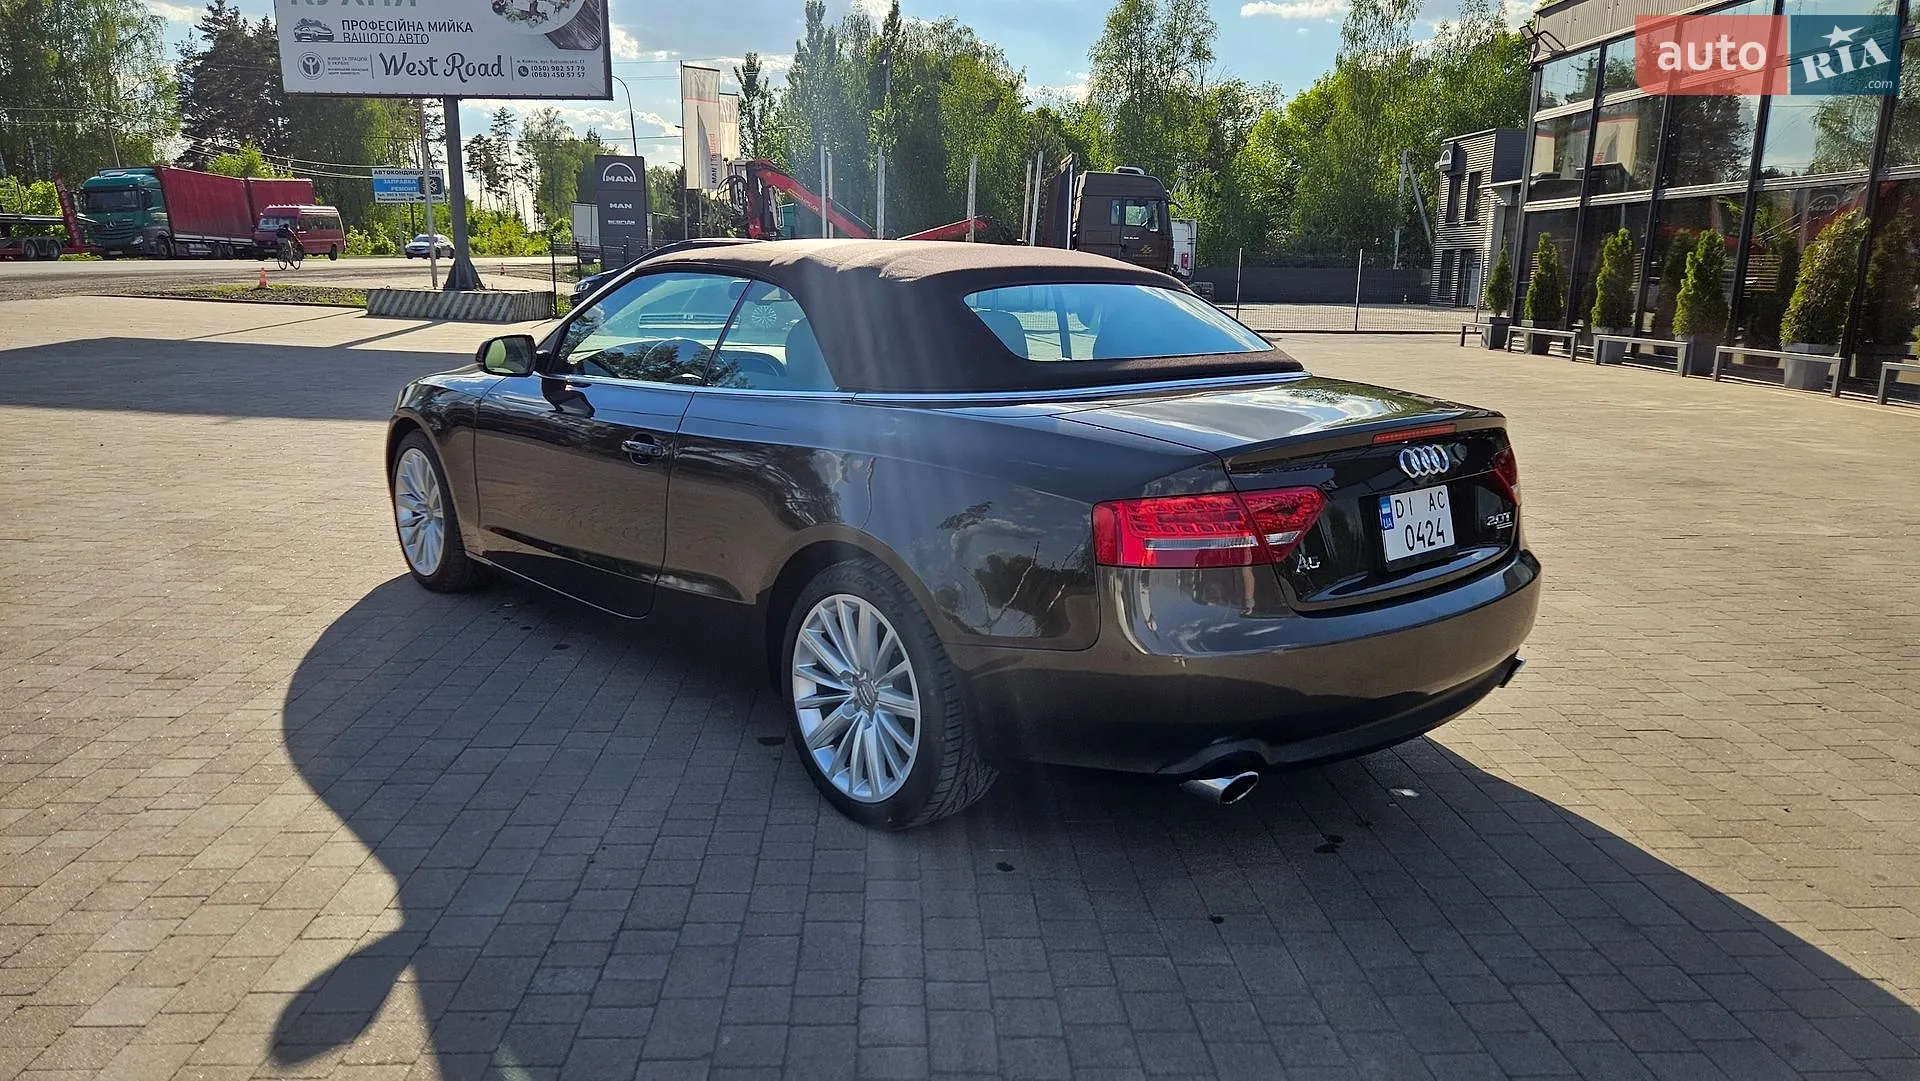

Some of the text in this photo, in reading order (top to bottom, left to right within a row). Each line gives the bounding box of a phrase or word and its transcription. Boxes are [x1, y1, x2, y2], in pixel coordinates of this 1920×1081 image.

[342, 19, 473, 32] ПРОФЕСІЙНА МИЙКА
[343, 32, 429, 44] ВАШОГО АВТО
[379, 52, 504, 83] West Road
[1395, 491, 1445, 518] DI AC
[1383, 518, 1393, 529] UA
[1405, 518, 1445, 551] 0424
